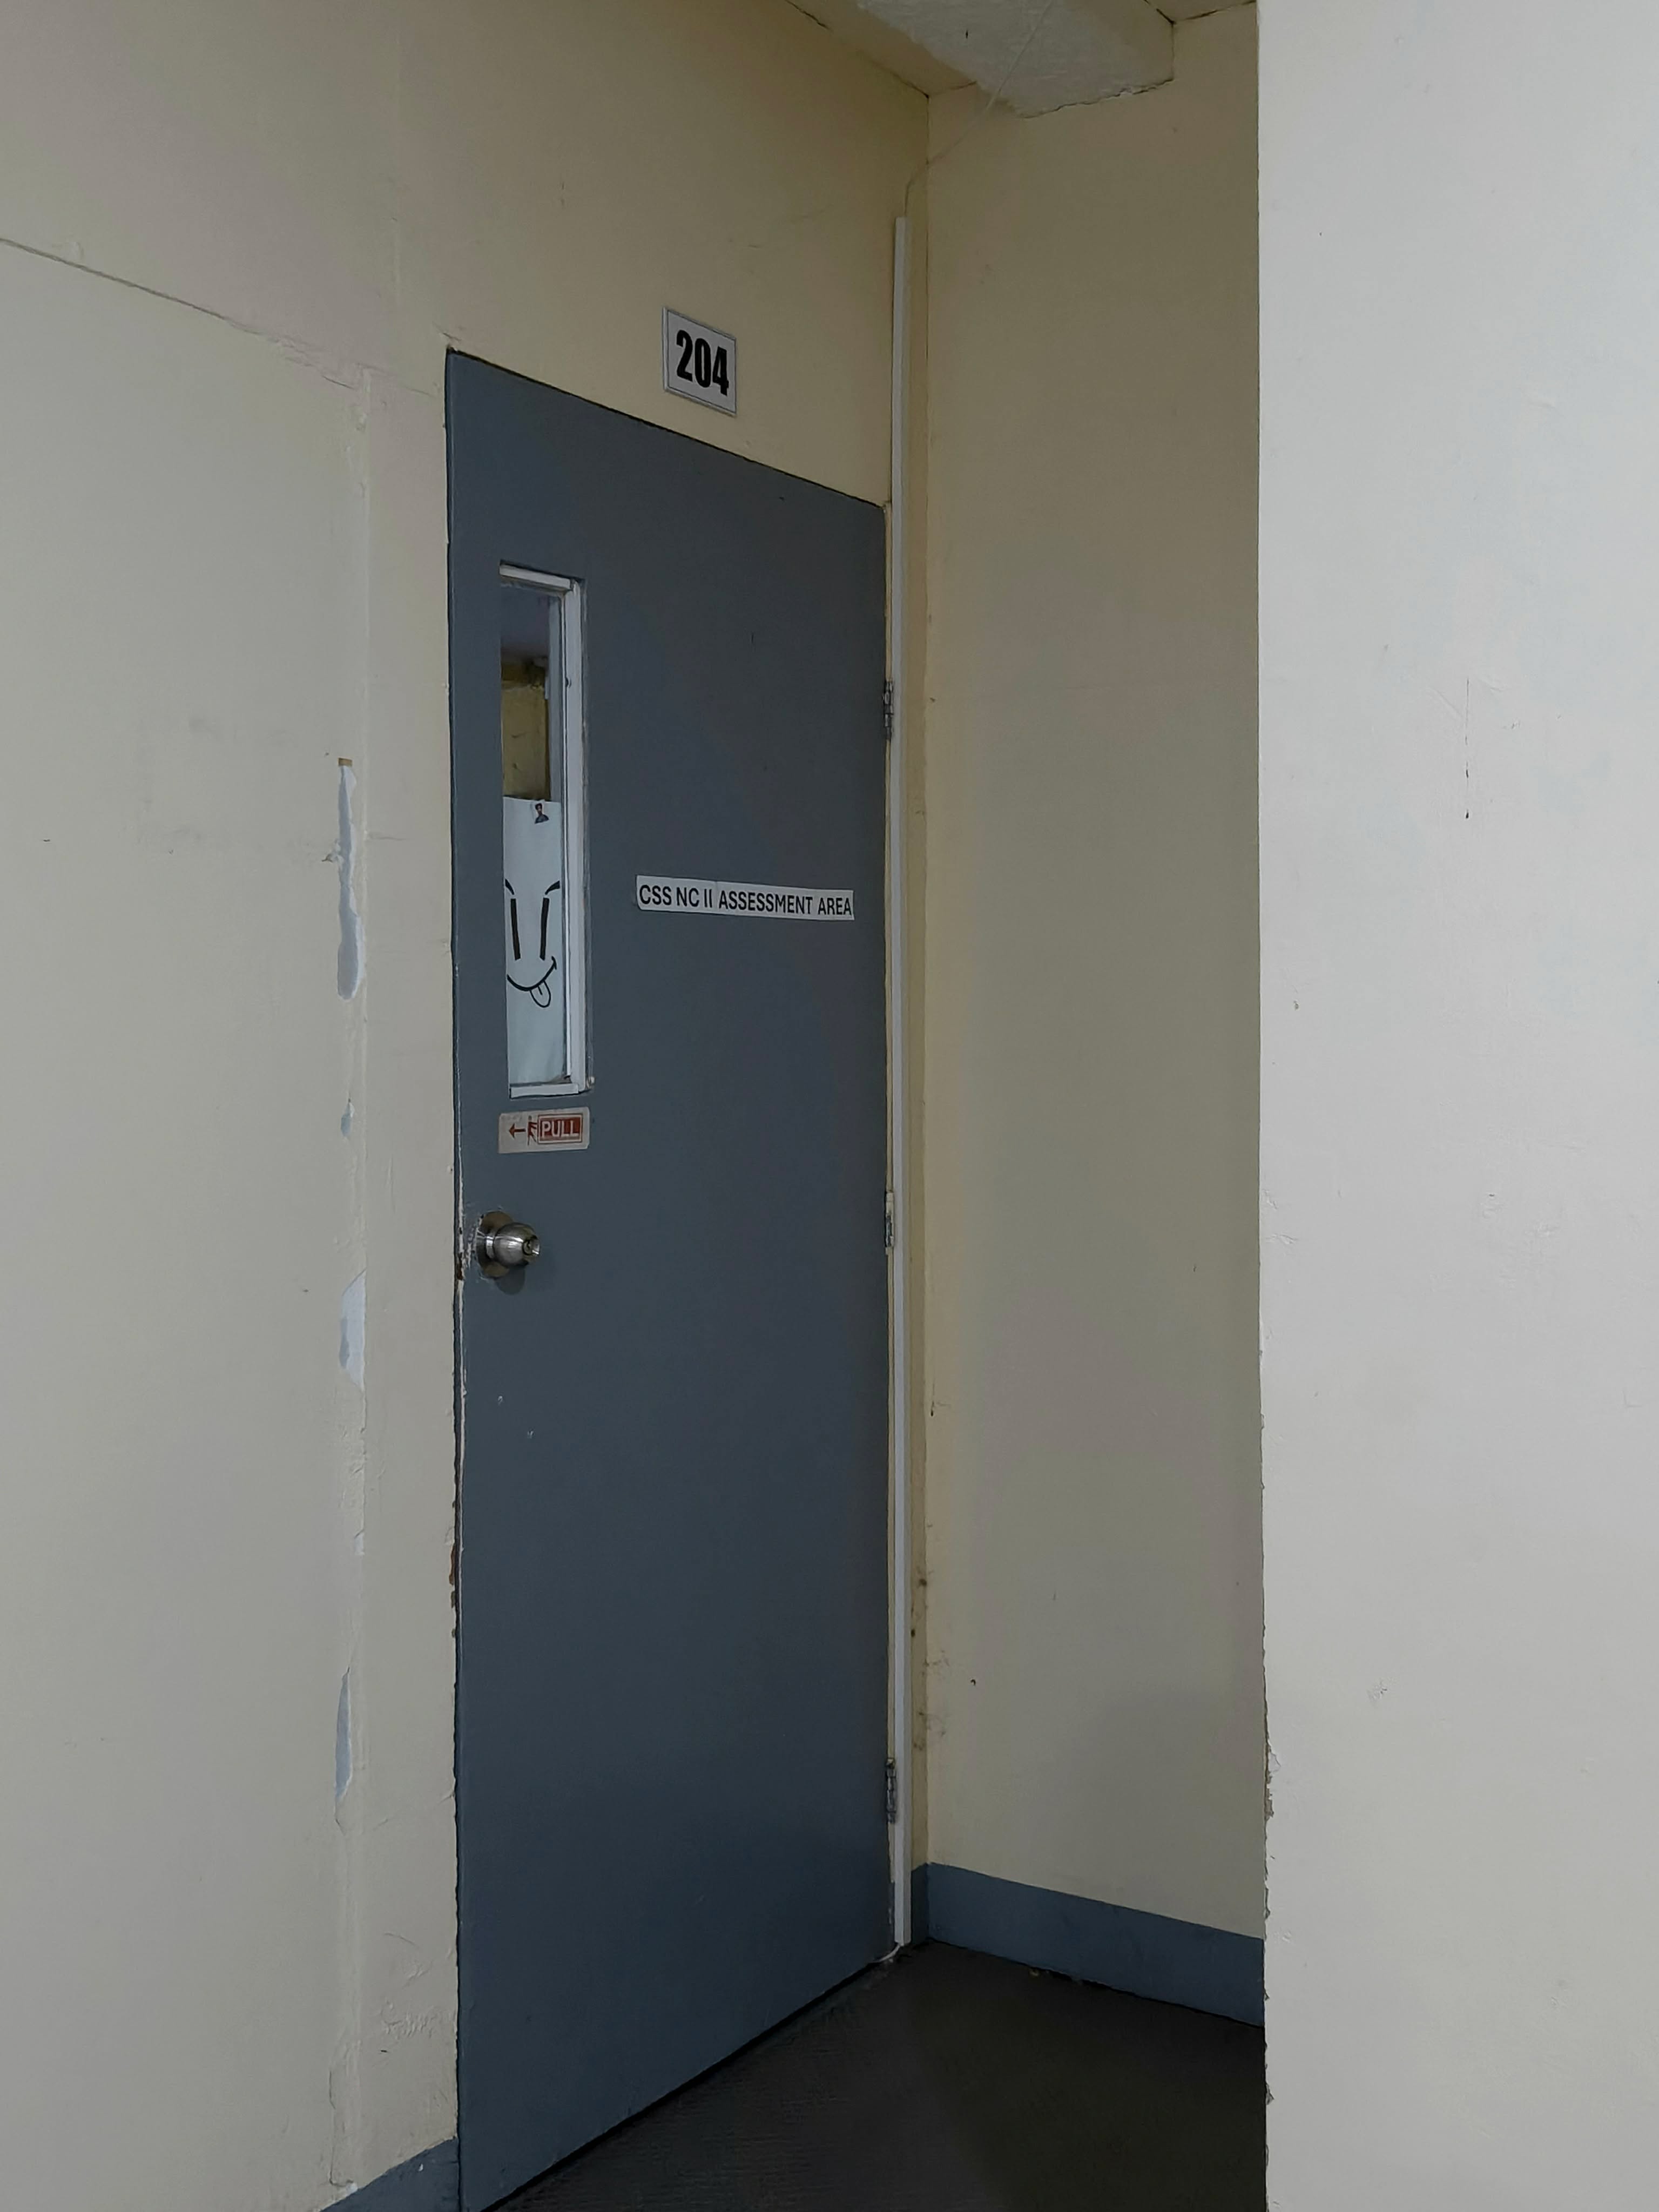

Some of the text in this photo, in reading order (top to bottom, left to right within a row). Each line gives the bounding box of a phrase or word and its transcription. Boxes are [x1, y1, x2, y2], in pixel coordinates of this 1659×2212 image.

[676, 329, 729, 396] 204
[639, 885, 852, 915] CSS NC II ASSESSMENT AREA
[542, 1120, 579, 1139] PULL
